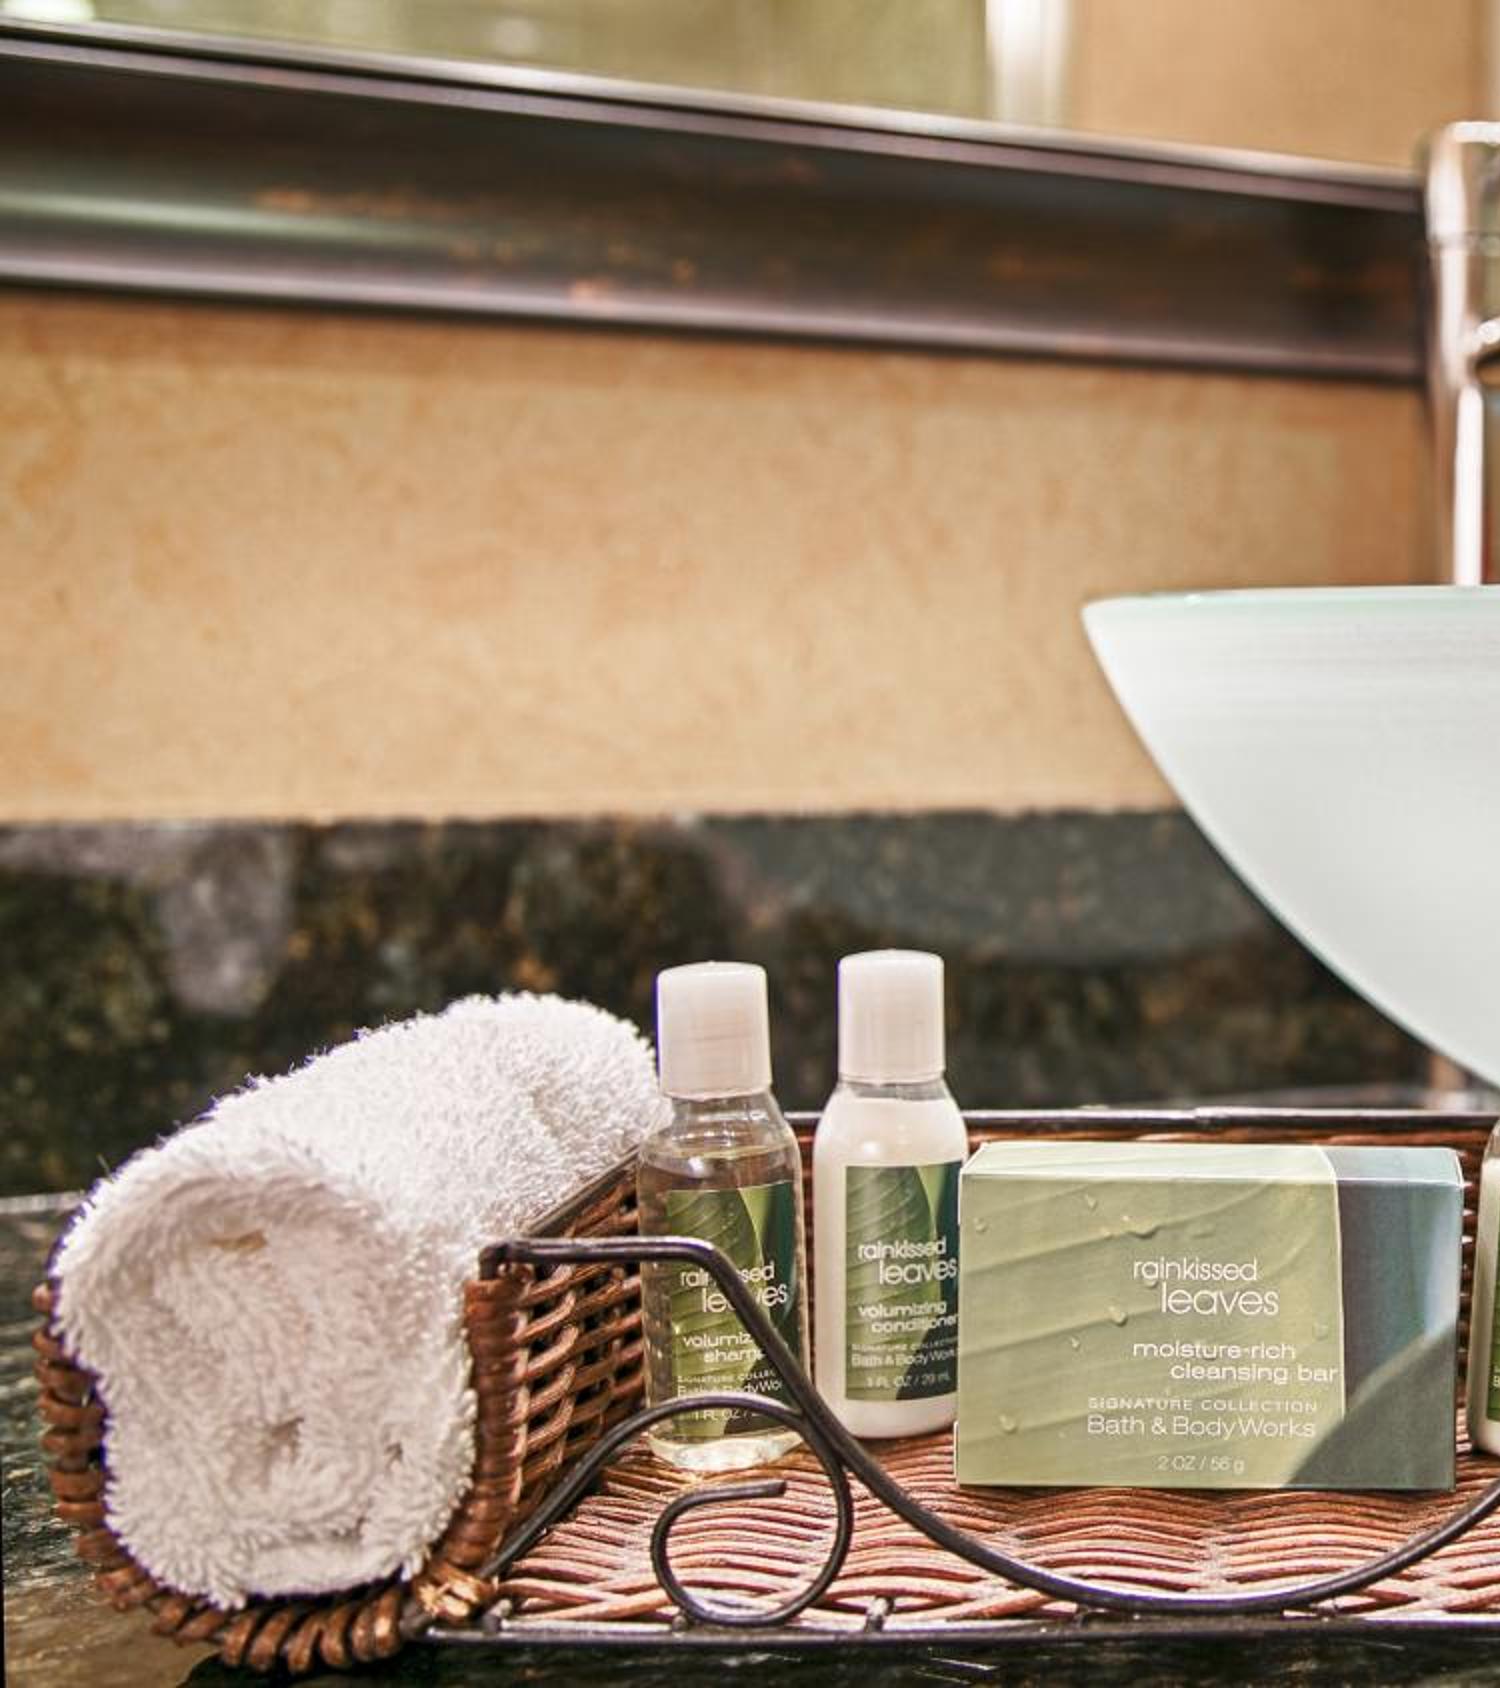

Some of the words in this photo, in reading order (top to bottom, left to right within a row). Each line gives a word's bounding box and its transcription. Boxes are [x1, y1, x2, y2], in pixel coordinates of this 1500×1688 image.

[857, 1235, 947, 1260] rainkissed
[879, 1258, 957, 1286] leaves
[1132, 1256, 1258, 1281] rainkissed
[701, 1283, 788, 1313] lees
[858, 1301, 947, 1319] volumizing
[1160, 1282, 1280, 1315] leaves
[683, 1331, 754, 1348] volumiz
[1170, 1362, 1290, 1386] cleansing
[1297, 1363, 1340, 1382] bar
[1087, 1397, 1193, 1411] SIGNATURE
[1200, 1398, 1318, 1413] COLLECTION
[1087, 1415, 1146, 1435] Bath
[1151, 1416, 1168, 1435] &
[1156, 1456, 1169, 1471] 2
[1171, 1456, 1197, 1472] OZ
[1209, 1457, 1231, 1472] 56
[1232, 1459, 1246, 1475] g
